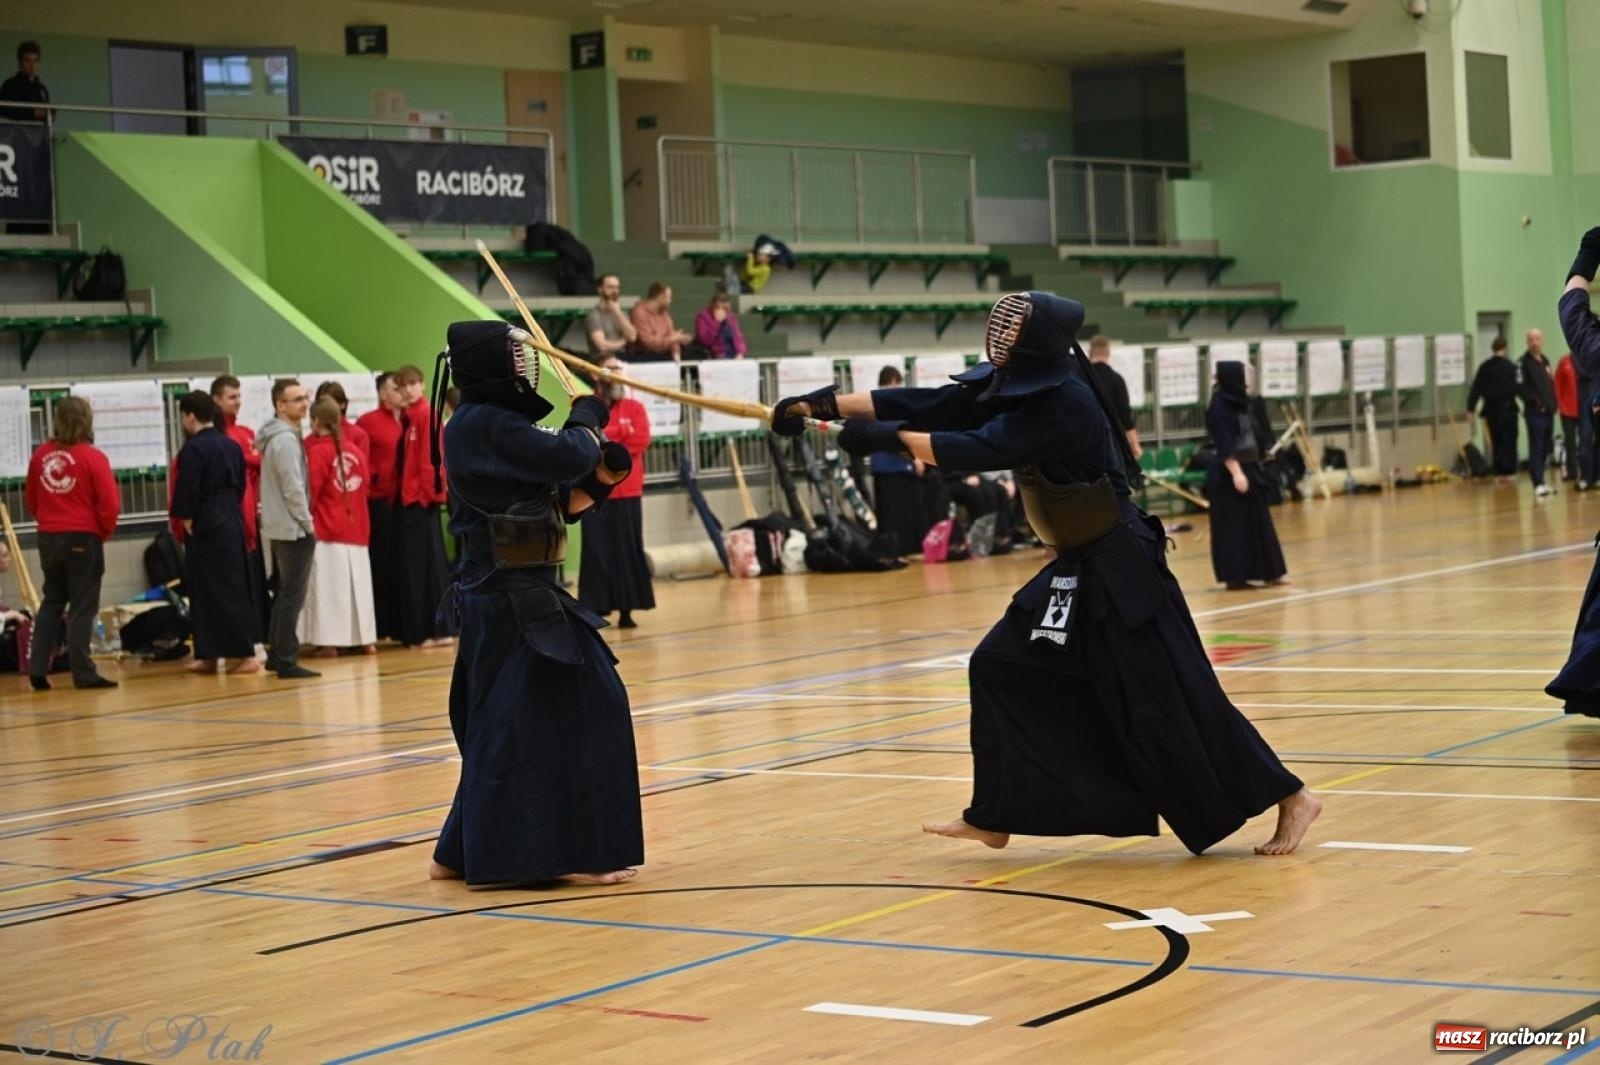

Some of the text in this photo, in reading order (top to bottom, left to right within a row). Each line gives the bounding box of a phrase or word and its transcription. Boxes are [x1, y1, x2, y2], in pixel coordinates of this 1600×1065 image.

[358, 34, 377, 52] F
[580, 45, 597, 66] F
[416, 165, 526, 198] RACIBÓRZ
